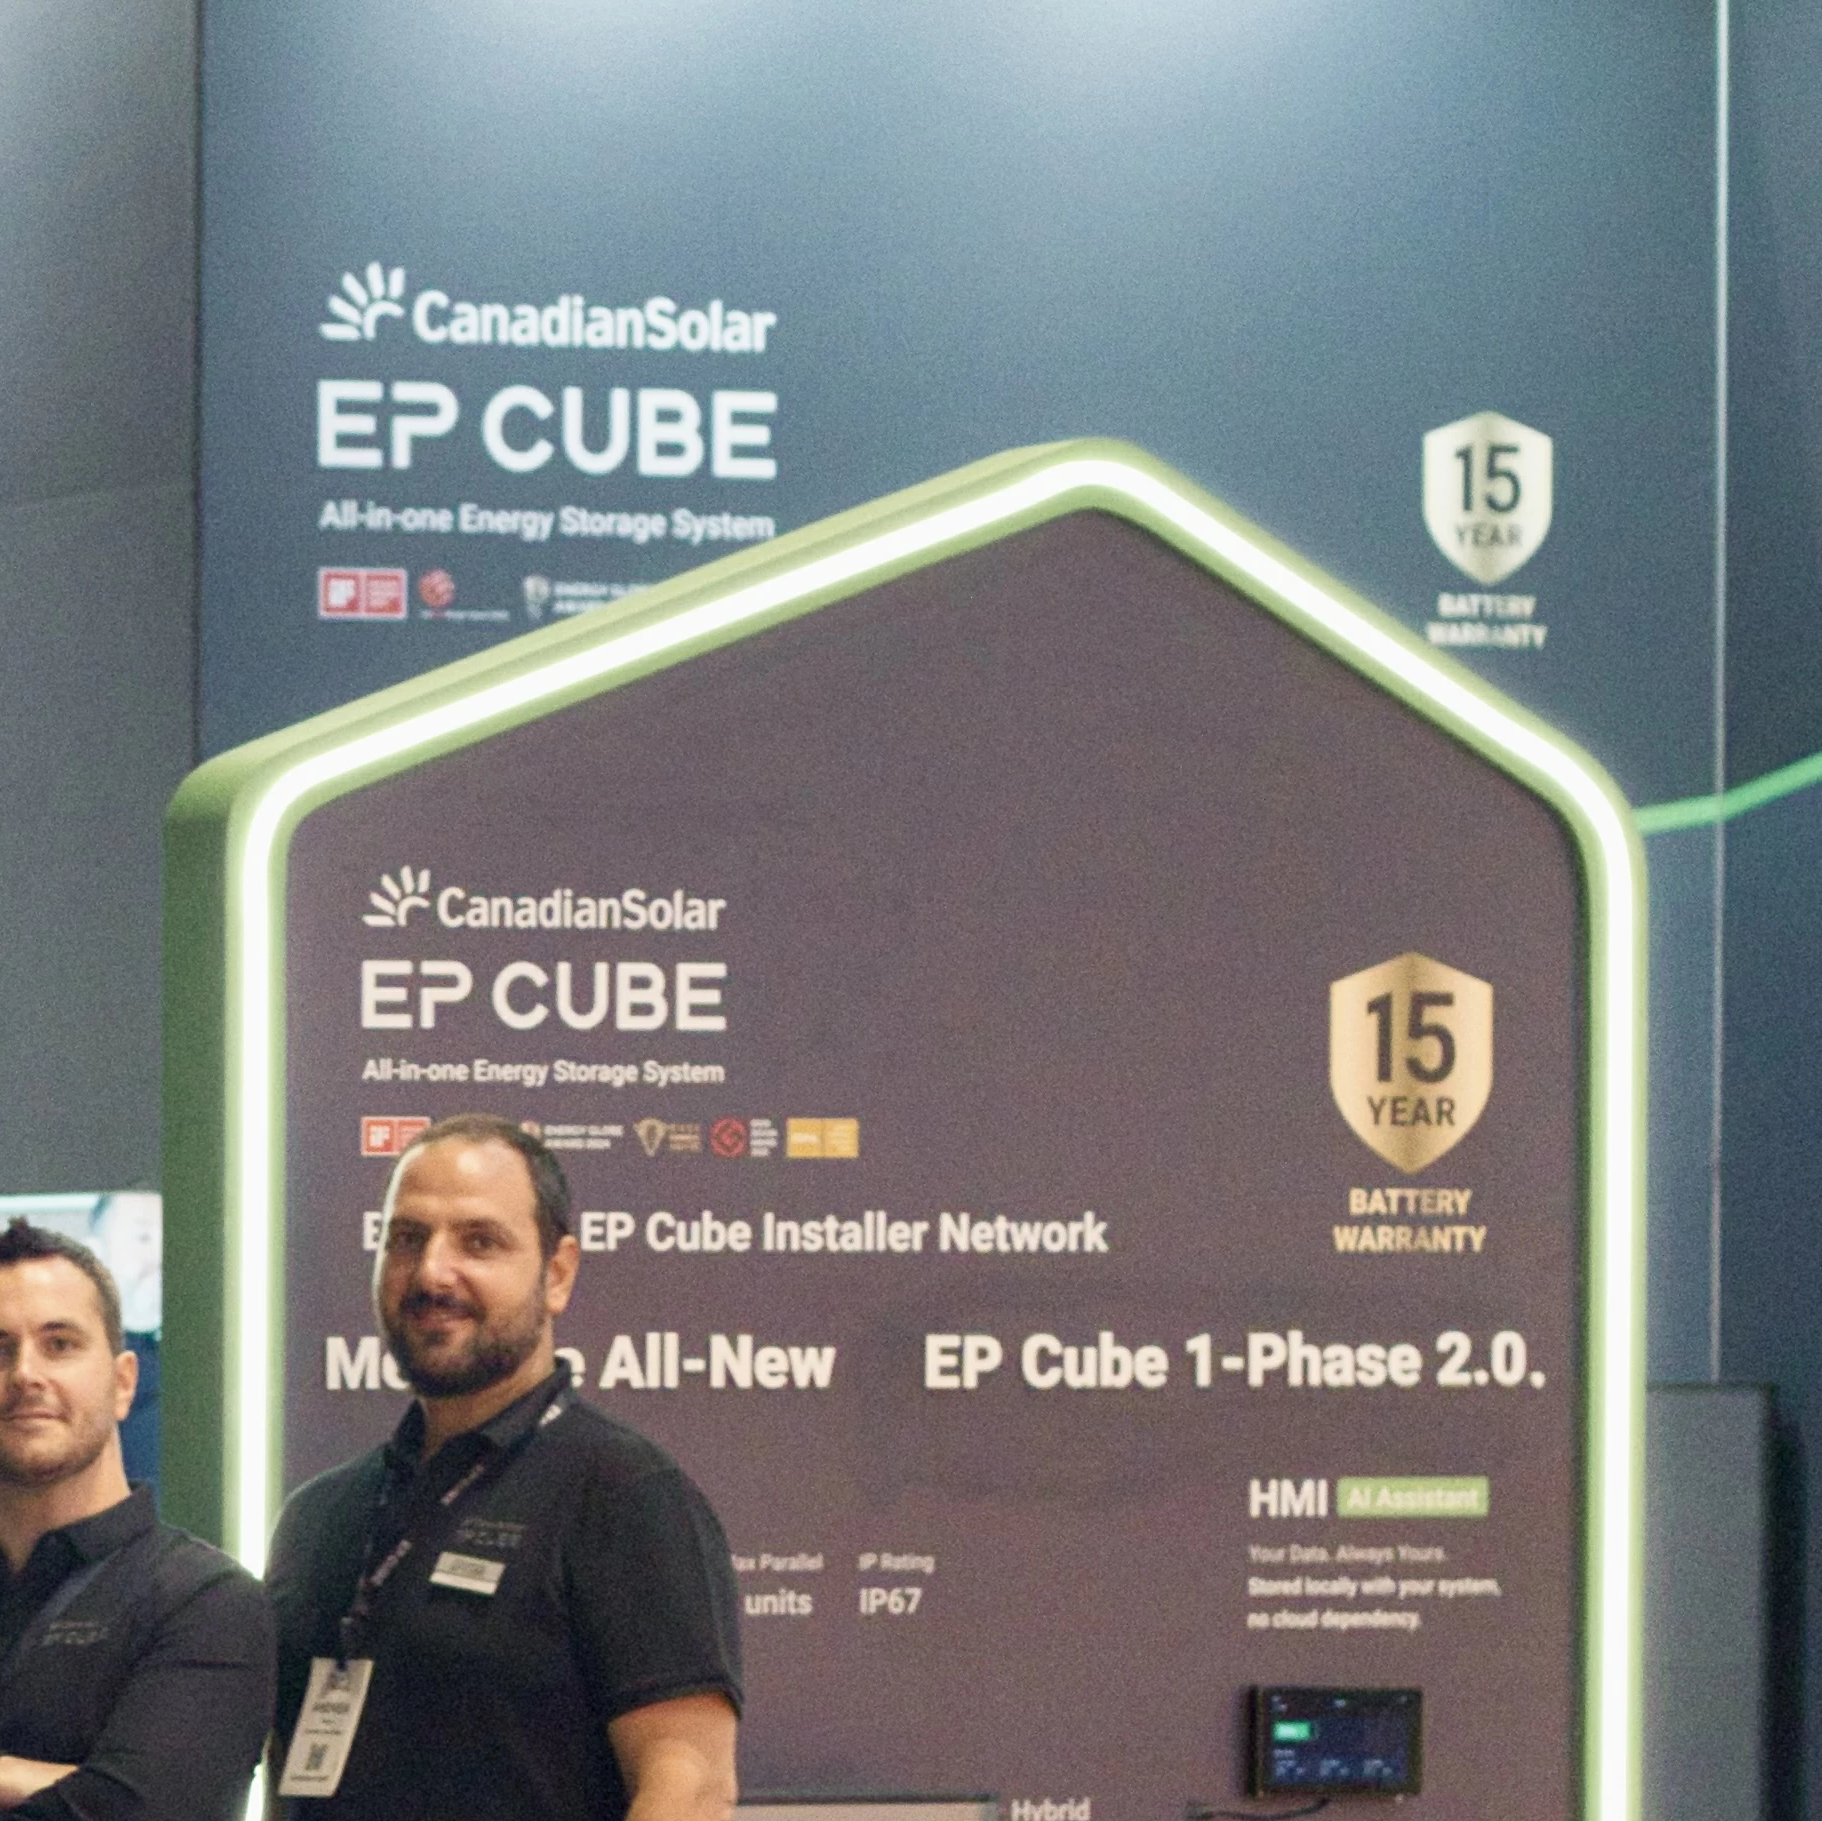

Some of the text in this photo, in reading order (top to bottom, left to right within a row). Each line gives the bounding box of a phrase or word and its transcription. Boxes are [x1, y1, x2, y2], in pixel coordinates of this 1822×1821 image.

[412, 289, 776, 354] CanadianSolar
[317, 379, 778, 479] EP CUBE
[1454, 444, 1522, 514] 15
[318, 500, 776, 546] All-in-one Energy Storage System
[1455, 522, 1523, 548] YEAR
[1437, 593, 1537, 619] BATTERY
[436, 887, 727, 931] CanadianSolar
[361, 959, 728, 1031] EP CUBE
[1366, 990, 1457, 1085] 15
[362, 1058, 725, 1088] All-in-one Energy Storage System
[1366, 1096, 1457, 1128] YEAR
[1348, 1188, 1472, 1216] BATTERY
[578, 1210, 1109, 1254] EP Cube Installer Network
[1333, 1225, 1486, 1254] WARRANTY
[598, 1331, 836, 1390] All-New
[923, 1333, 1003, 1390] EP
[1021, 1331, 1168, 1390] Cube
[1184, 1330, 1423, 1388] 1-Phase
[1435, 1329, 1547, 1389] 2.0.
[1249, 1478, 1479, 1519] HMI AI Assistant
[744, 1588, 814, 1616] units
[858, 1587, 923, 1616] IP67
[1359, 1575, 1397, 1596] with
[1272, 1608, 1319, 1630] cloud
